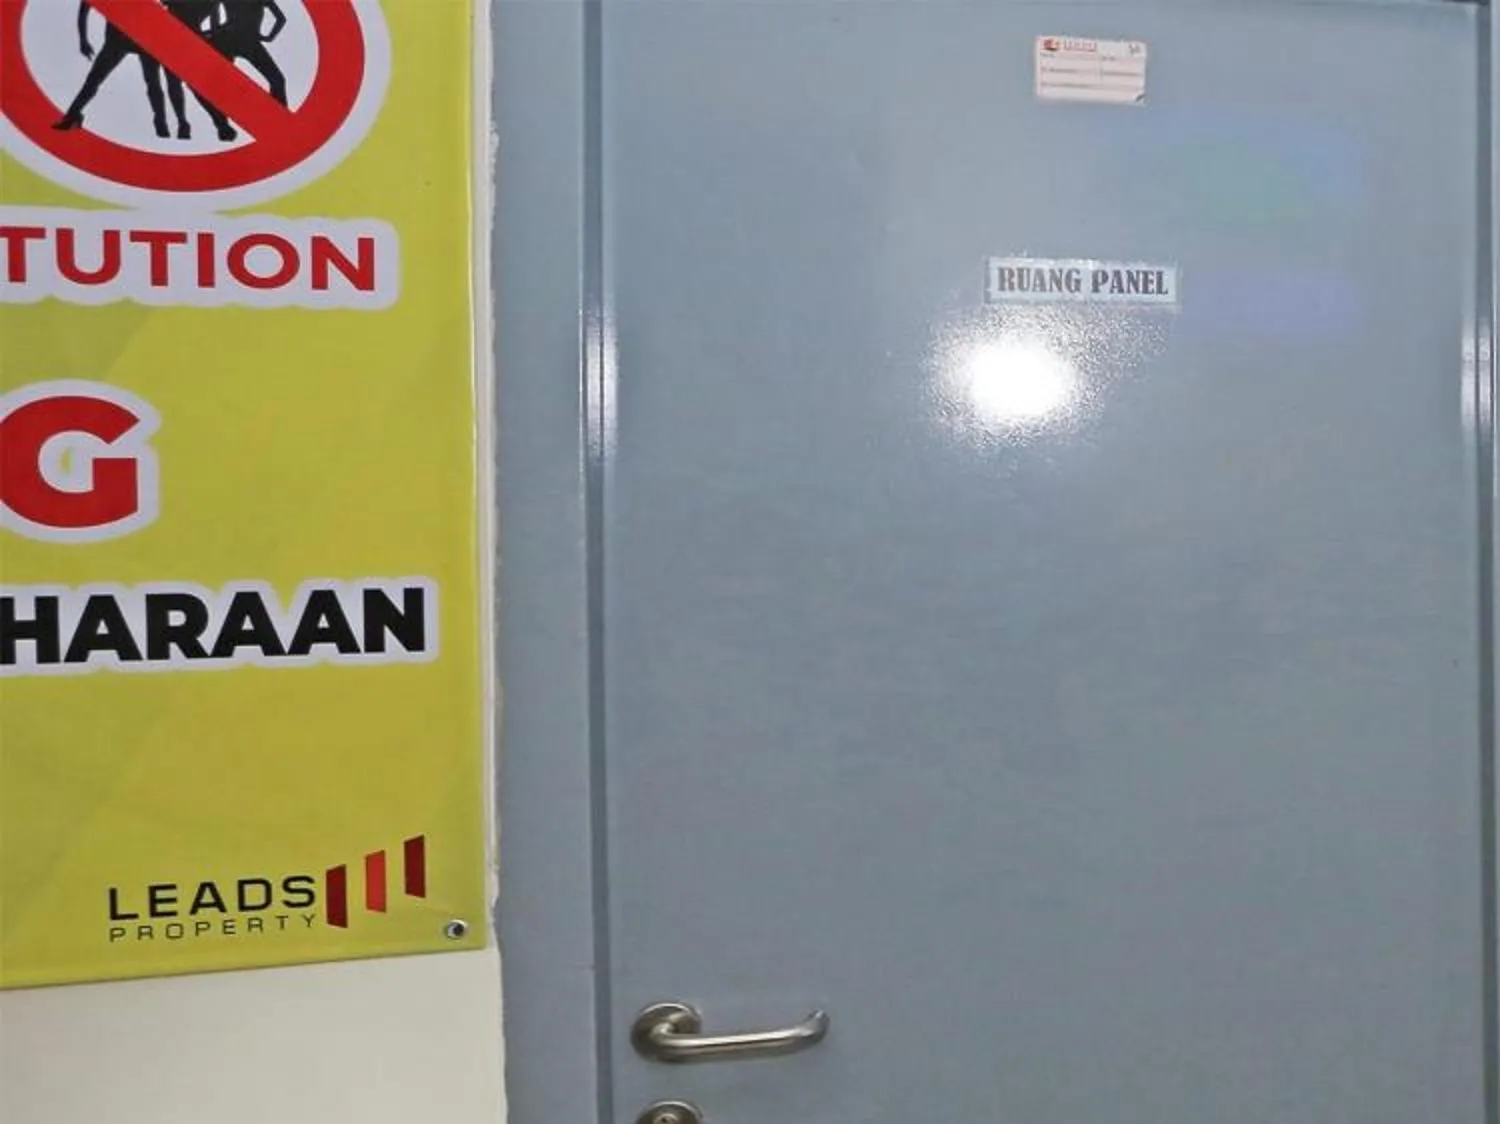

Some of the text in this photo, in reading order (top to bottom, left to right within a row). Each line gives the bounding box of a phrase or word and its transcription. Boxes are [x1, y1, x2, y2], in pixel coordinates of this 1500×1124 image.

[0, 225, 375, 291] TUTION
[998, 267, 1168, 295] RUANG PANEL
[0, 395, 140, 528] G
[0, 587, 425, 664] HARAAN
[108, 875, 316, 921] LEADS
[109, 913, 317, 942] PROPERTY
